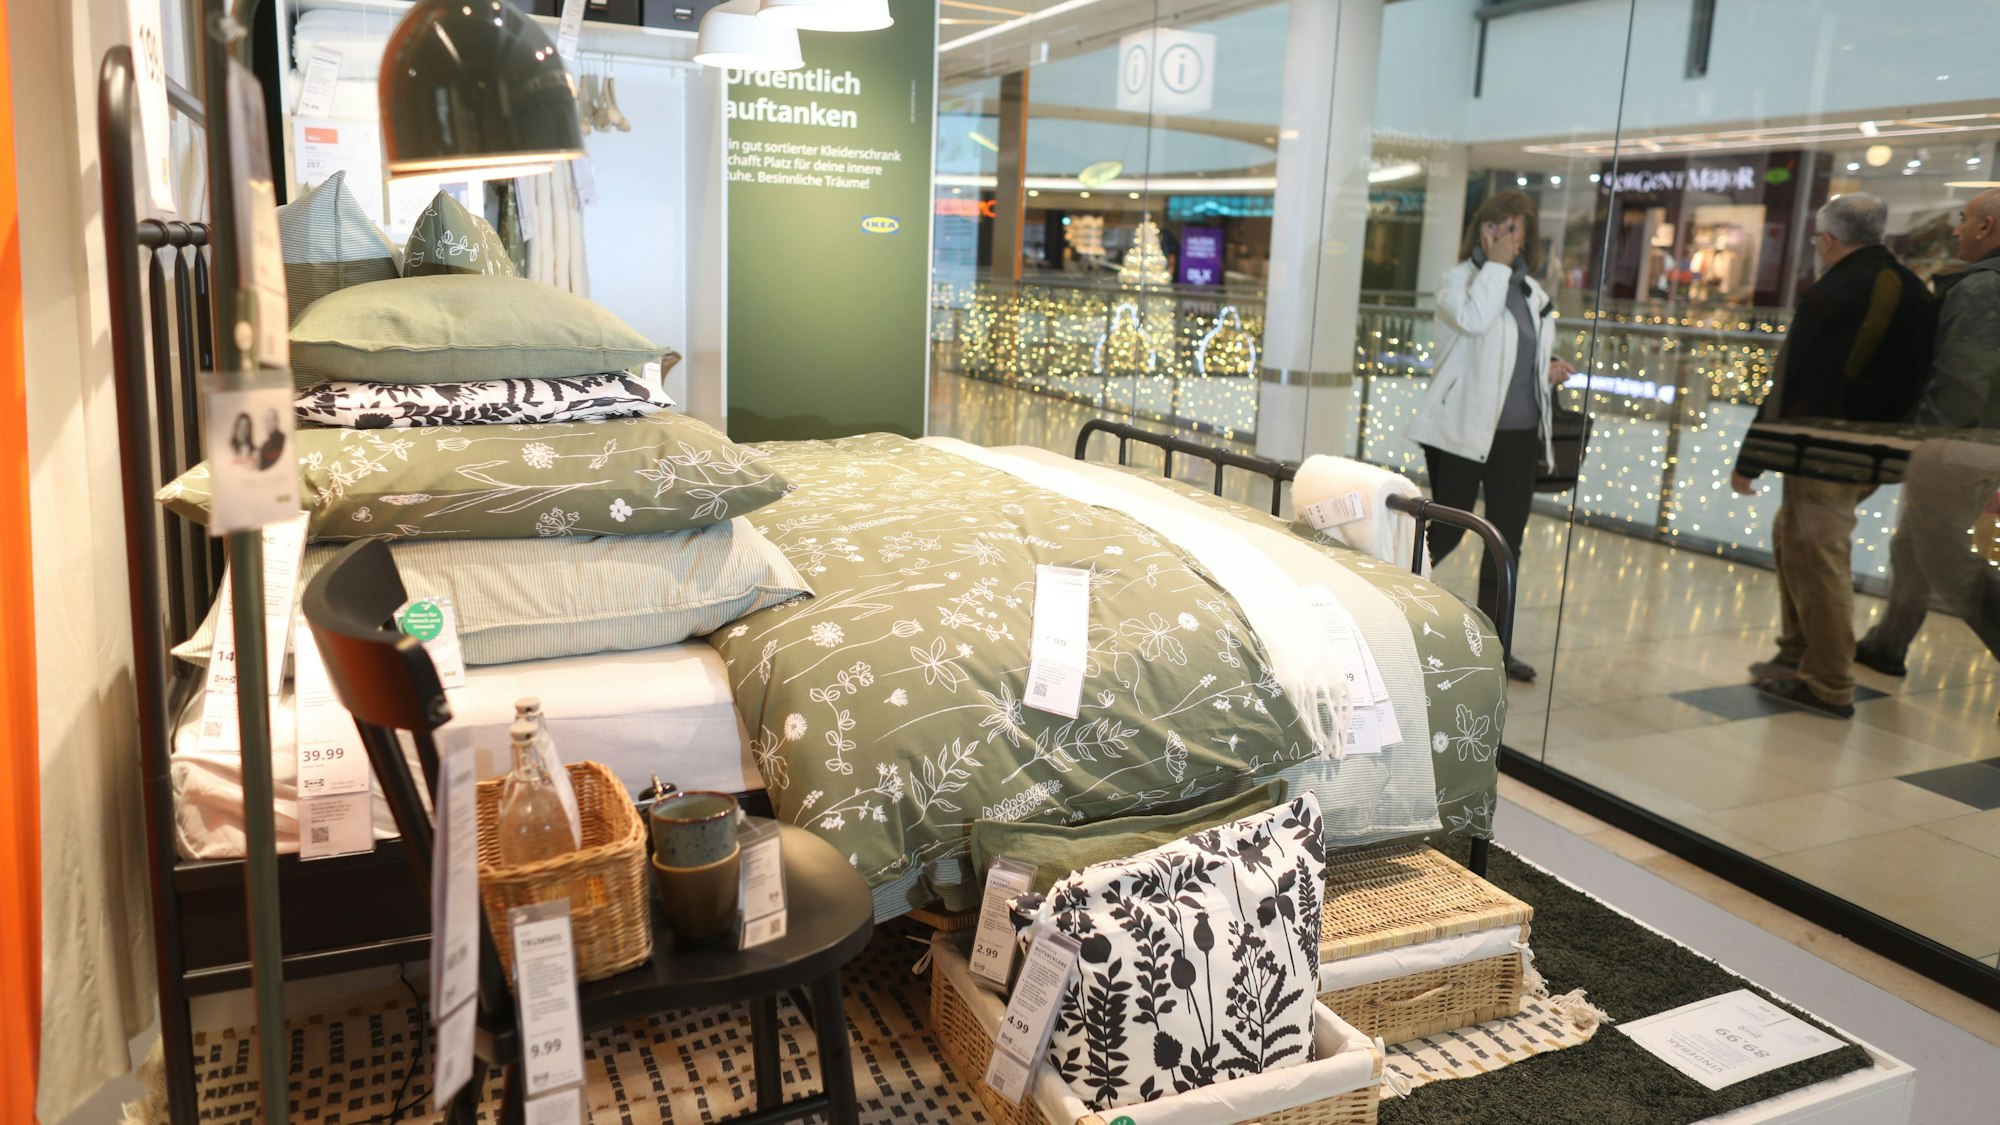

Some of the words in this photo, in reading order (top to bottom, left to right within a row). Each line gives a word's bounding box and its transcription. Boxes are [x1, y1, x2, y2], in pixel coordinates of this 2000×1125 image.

[727, 97, 857, 128] auftanken
[728, 138, 739, 149] in
[742, 141, 762, 154] gut
[764, 142, 818, 156] sortierter
[820, 145, 902, 162] Kleiderschrank
[728, 154, 761, 167] chafft
[764, 156, 791, 170] Platz
[793, 156, 812, 170] für
[814, 159, 845, 173] deine
[847, 162, 883, 175] innere
[727, 170, 755, 182] uhe.
[758, 171, 823, 186] Besinnliche
[825, 175, 870, 189] Träume!
[302, 747, 344, 762] 39.99
[976, 943, 999, 959] 2.99
[1007, 1014, 1029, 1035] 4.99
[530, 1037, 562, 1059] 9.99
[1714, 1027, 1770, 1059] 89.99
